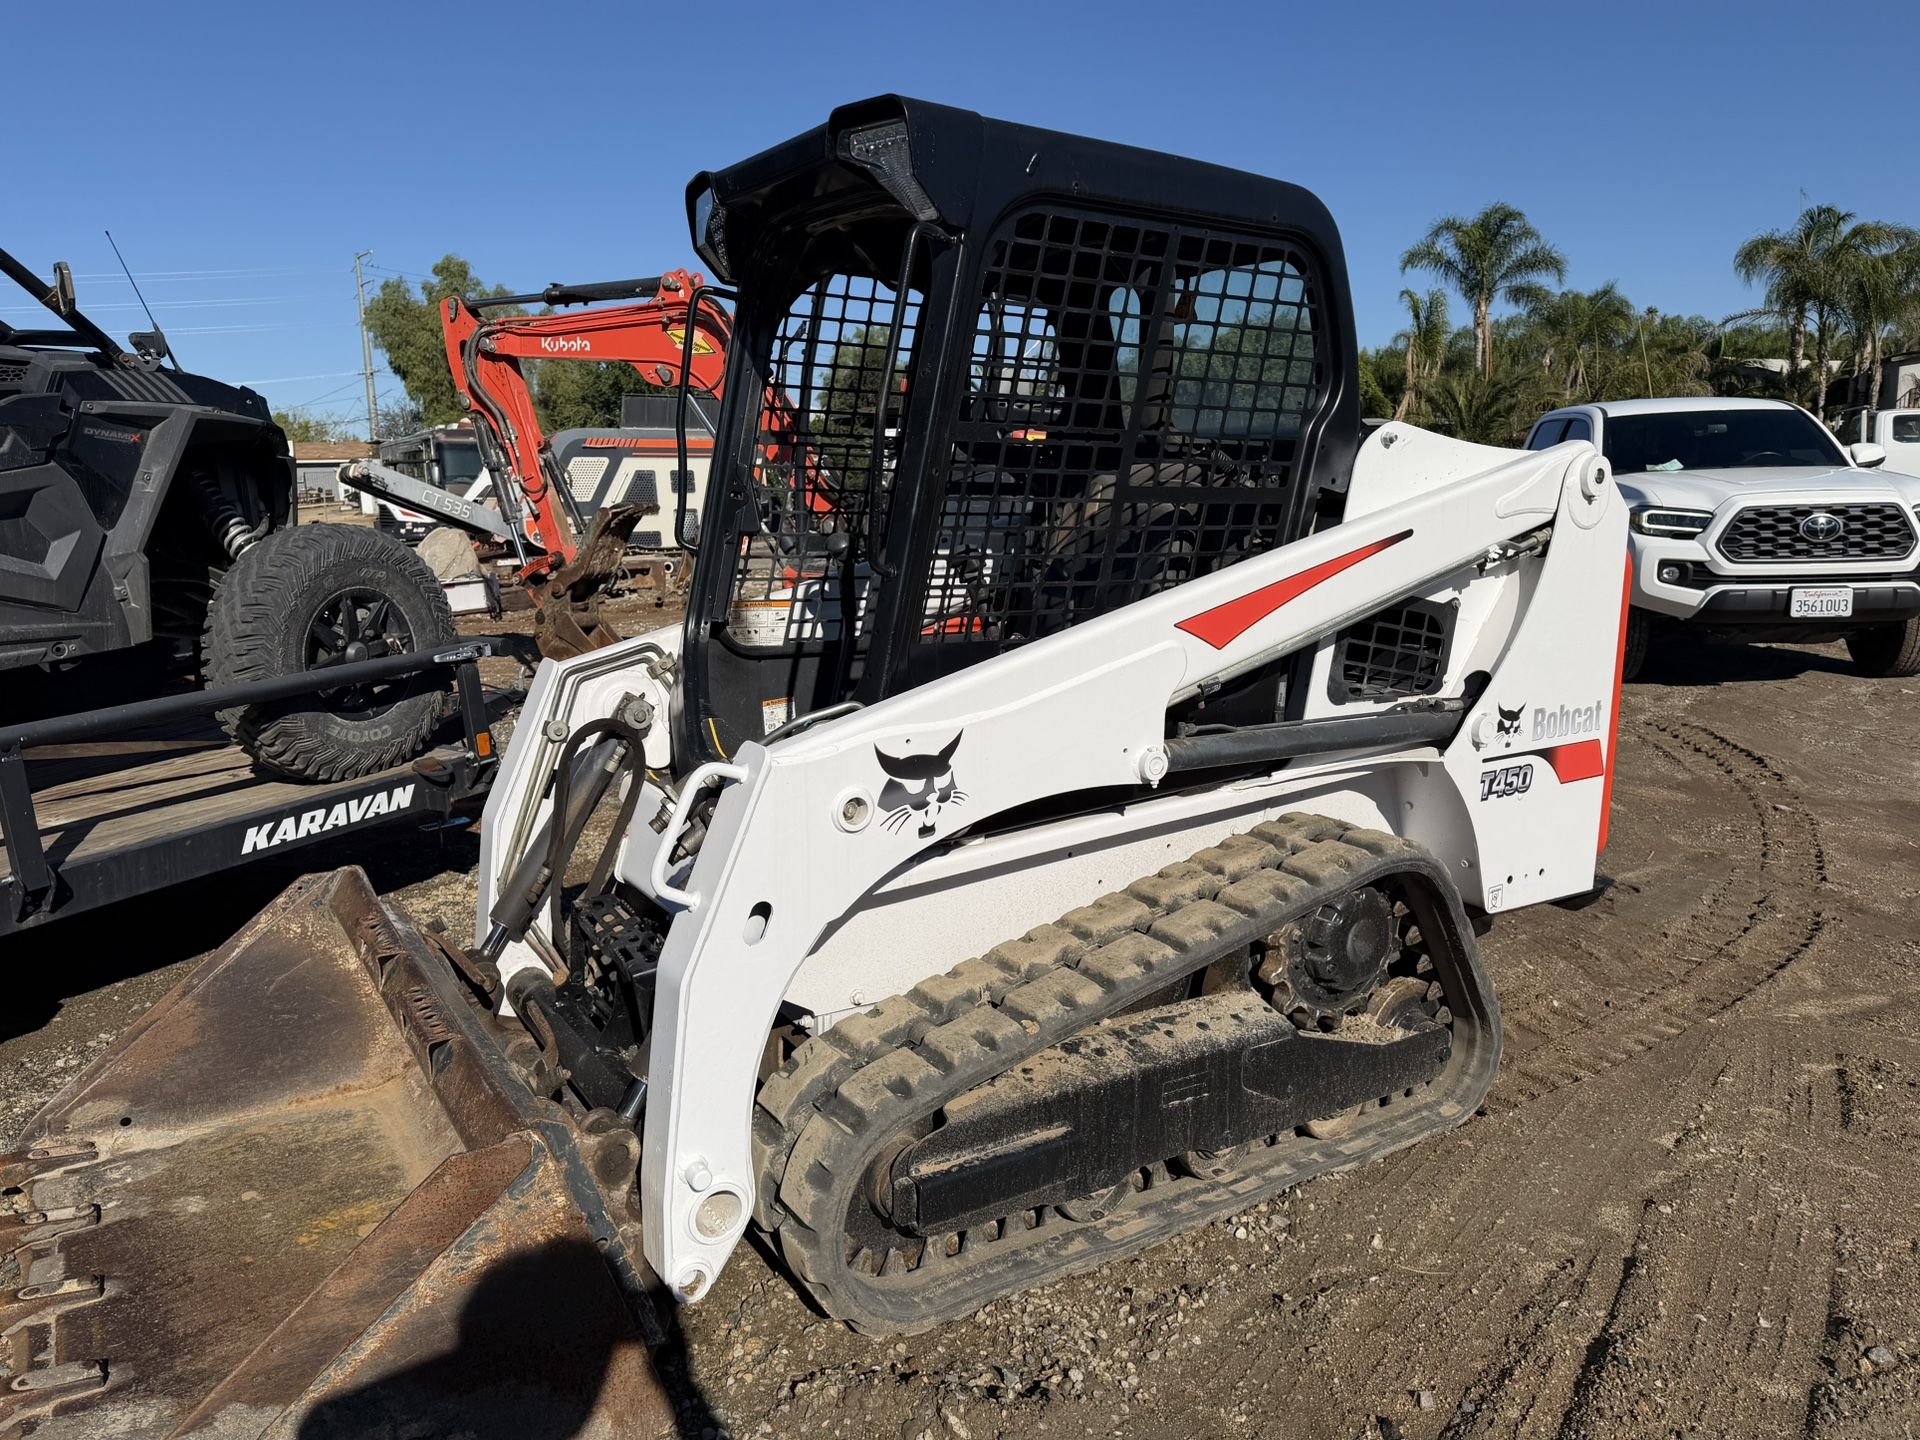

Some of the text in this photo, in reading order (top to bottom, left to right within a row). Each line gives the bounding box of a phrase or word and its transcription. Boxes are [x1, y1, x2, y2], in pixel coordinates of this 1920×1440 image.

[541, 336, 591, 352] Kubota
[84, 427, 143, 444] DYNAMIX
[422, 489, 472, 518] CT 535
[1795, 599, 1849, 612] 35610U3
[1532, 700, 1602, 741] Bobcat
[1480, 763, 1534, 802] T450
[241, 783, 416, 855] KARAVAN
